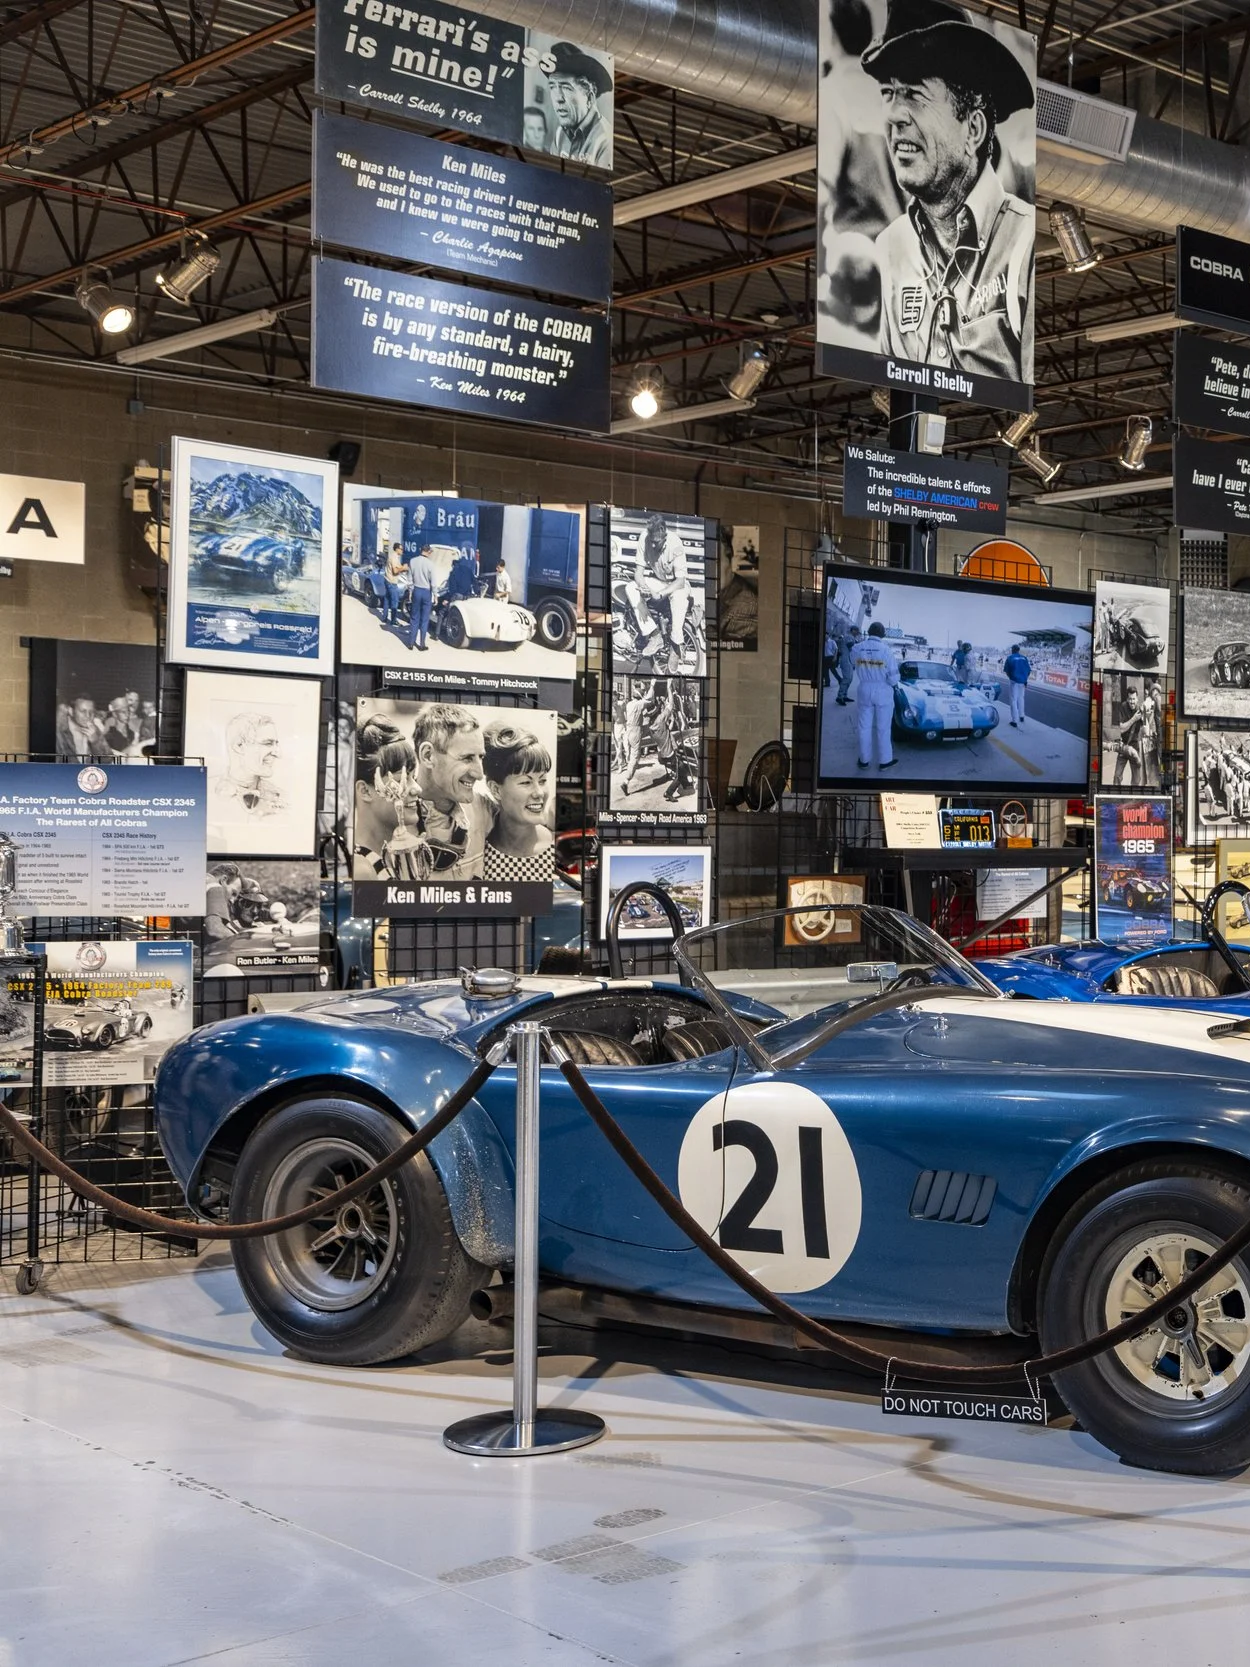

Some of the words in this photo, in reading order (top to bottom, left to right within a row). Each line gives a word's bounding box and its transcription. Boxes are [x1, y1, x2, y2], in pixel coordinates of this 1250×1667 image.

[344, 24, 378, 58] is
[501, 40, 558, 73] ass
[359, 82, 403, 105] Carroll
[407, 96, 446, 118] Shelby
[451, 107, 482, 125] 1964
[442, 154, 466, 175] Ken
[471, 162, 506, 184] Miles
[360, 162, 384, 176] was
[387, 164, 406, 181] the
[409, 169, 434, 188] best
[436, 177, 471, 199] racing
[473, 185, 506, 206] driver
[508, 194, 514, 208] I
[516, 199, 540, 214] ever
[542, 203, 580, 224] worked
[581, 212, 600, 229] for.
[1189, 255, 1244, 282] COBRA
[386, 289, 425, 310] race
[430, 296, 489, 323] version
[493, 308, 511, 328] of
[513, 310, 539, 333] the
[542, 317, 593, 344] COBRA
[362, 307, 378, 328] is
[382, 312, 404, 335] by
[407, 319, 437, 342] any
[441, 324, 514, 357] standard,
[518, 341, 529, 356] a
[532, 340, 575, 369] hairy,
[372, 335, 487, 377] fire-breathing
[430, 376, 454, 393] Ken
[457, 380, 490, 398] Miles
[495, 388, 526, 404] 1964
[886, 360, 930, 386] Carroll
[933, 370, 974, 398] Shelby
[1204, 375, 1239, 397] believe
[1241, 382, 1250, 399] in
[848, 446, 864, 460] We
[865, 449, 896, 465] Salute:
[867, 466, 884, 480] The
[885, 469, 927, 486] incredible
[927, 476, 953, 489] talent
[954, 479, 962, 491] &
[963, 481, 992, 496] efforts
[1192, 469, 1216, 488] have
[1218, 473, 1223, 489] I
[1224, 476, 1247, 493] ever
[866, 500, 880, 512] led
[881, 501, 893, 516] by
[893, 502, 910, 517] Phil
[911, 506, 959, 523] Remington.
[867, 485, 877, 496] of
[877, 485, 893, 498] the
[894, 486, 930, 503] SHELBY
[930, 492, 978, 509] AMERICAN
[979, 501, 1000, 512] crew
[6, 497, 59, 539] A
[384, 670, 402, 680] CSX
[403, 671, 426, 682] 2155
[427, 673, 444, 683] Ken
[445, 675, 466, 685] Miles
[471, 677, 499, 689] Tommy
[500, 679, 538, 689] Hitchcock
[12, 796, 49, 806] Factory
[50, 796, 76, 805] Team
[78, 797, 107, 806] Cobra
[108, 798, 151, 807] Roadster
[152, 798, 172, 807] CSX
[174, 798, 196, 807] 2345
[18, 807, 41, 815] F.I.A.
[44, 807, 72, 816] World
[73, 808, 140, 817] Manufacturers
[142, 808, 189, 819] Champion
[36, 818, 54, 826] The
[56, 818, 87, 827] Rarest
[88, 818, 99, 827] of
[100, 818, 112, 827] All
[114, 818, 148, 828] Cobras
[599, 811, 613, 823] Miles
[640, 813, 657, 825] Shelby
[658, 814, 671, 824] Road
[672, 813, 693, 825] America
[693, 814, 707, 825] 1963
[969, 825, 990, 842] 013
[1122, 824, 1164, 841] champion
[1122, 839, 1155, 854] 1965
[387, 886, 415, 904] Ken
[420, 886, 461, 904] Miles
[465, 886, 477, 904] &
[481, 887, 512, 904] Fans
[237, 956, 253, 967] Ron
[254, 956, 278, 966] Butler
[282, 955, 297, 965] Ken
[297, 955, 319, 965] Miles
[712, 1119, 830, 1259] 21
[884, 1396, 906, 1412] DO
[910, 1398, 940, 1414] NOT
[944, 1400, 996, 1418] TOUCH
[1000, 1404, 1043, 1421] CARS
